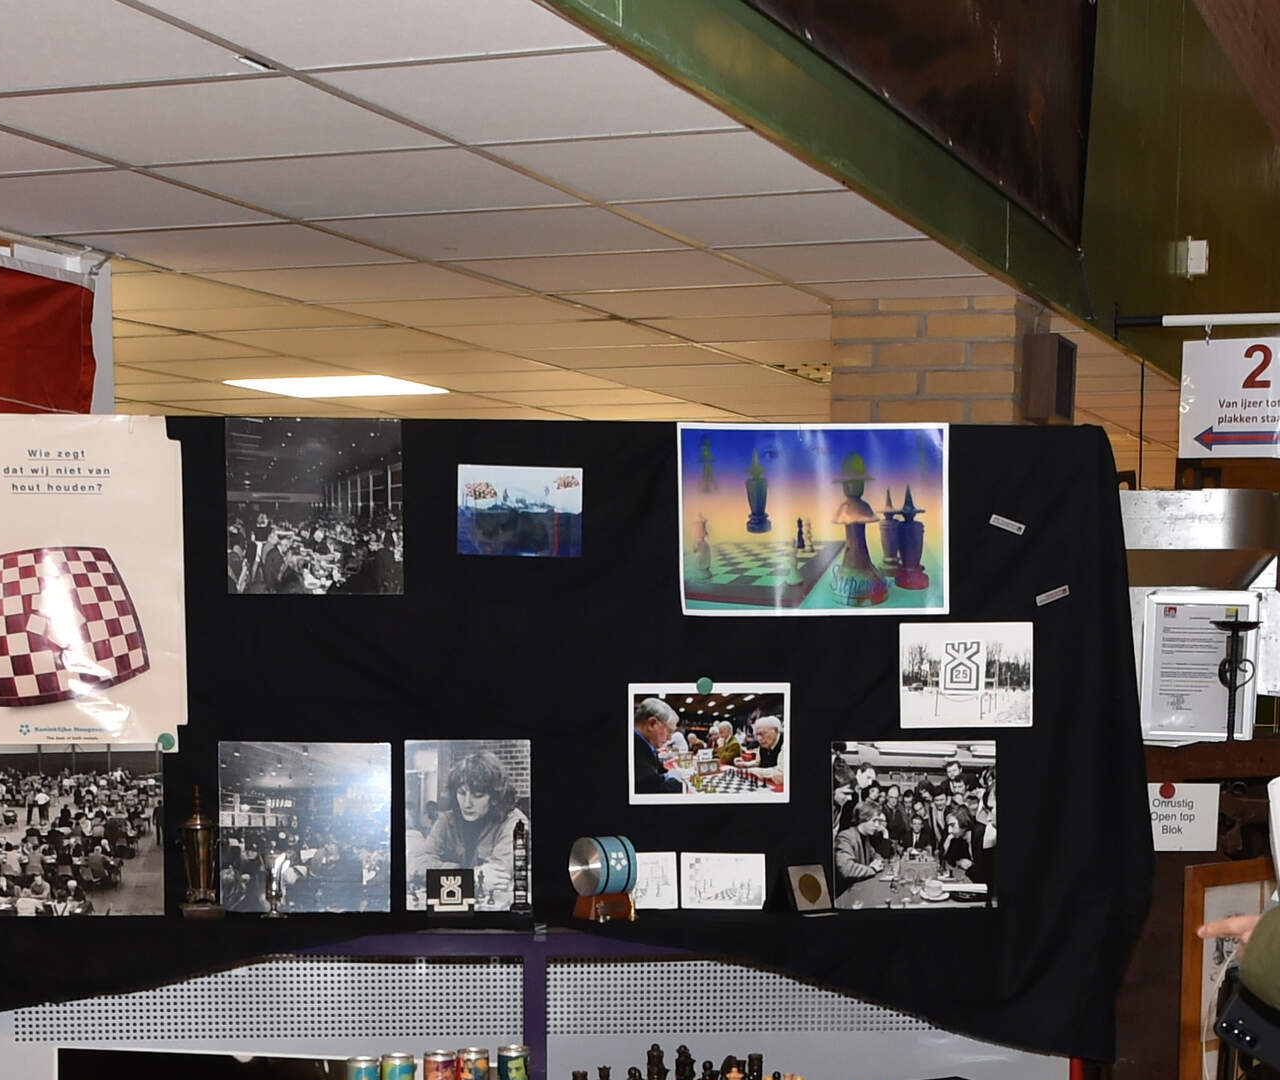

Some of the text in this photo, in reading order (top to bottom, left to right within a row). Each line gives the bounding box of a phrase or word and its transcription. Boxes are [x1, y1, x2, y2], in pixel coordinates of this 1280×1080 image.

[1242, 344, 1273, 389] 2
[1218, 399, 1237, 408] Van
[1240, 399, 1263, 412] ijzer
[1218, 413, 1258, 425] plakken
[27, 449, 85, 460] Wie zegt
[3, 466, 111, 476] dat wij niet van
[11, 483, 102, 492] hout houden?
[955, 669, 968, 679] 25
[1152, 799, 1194, 810] Onrustig
[1151, 811, 1195, 823] Open top
[1162, 824, 1183, 834] Blok
